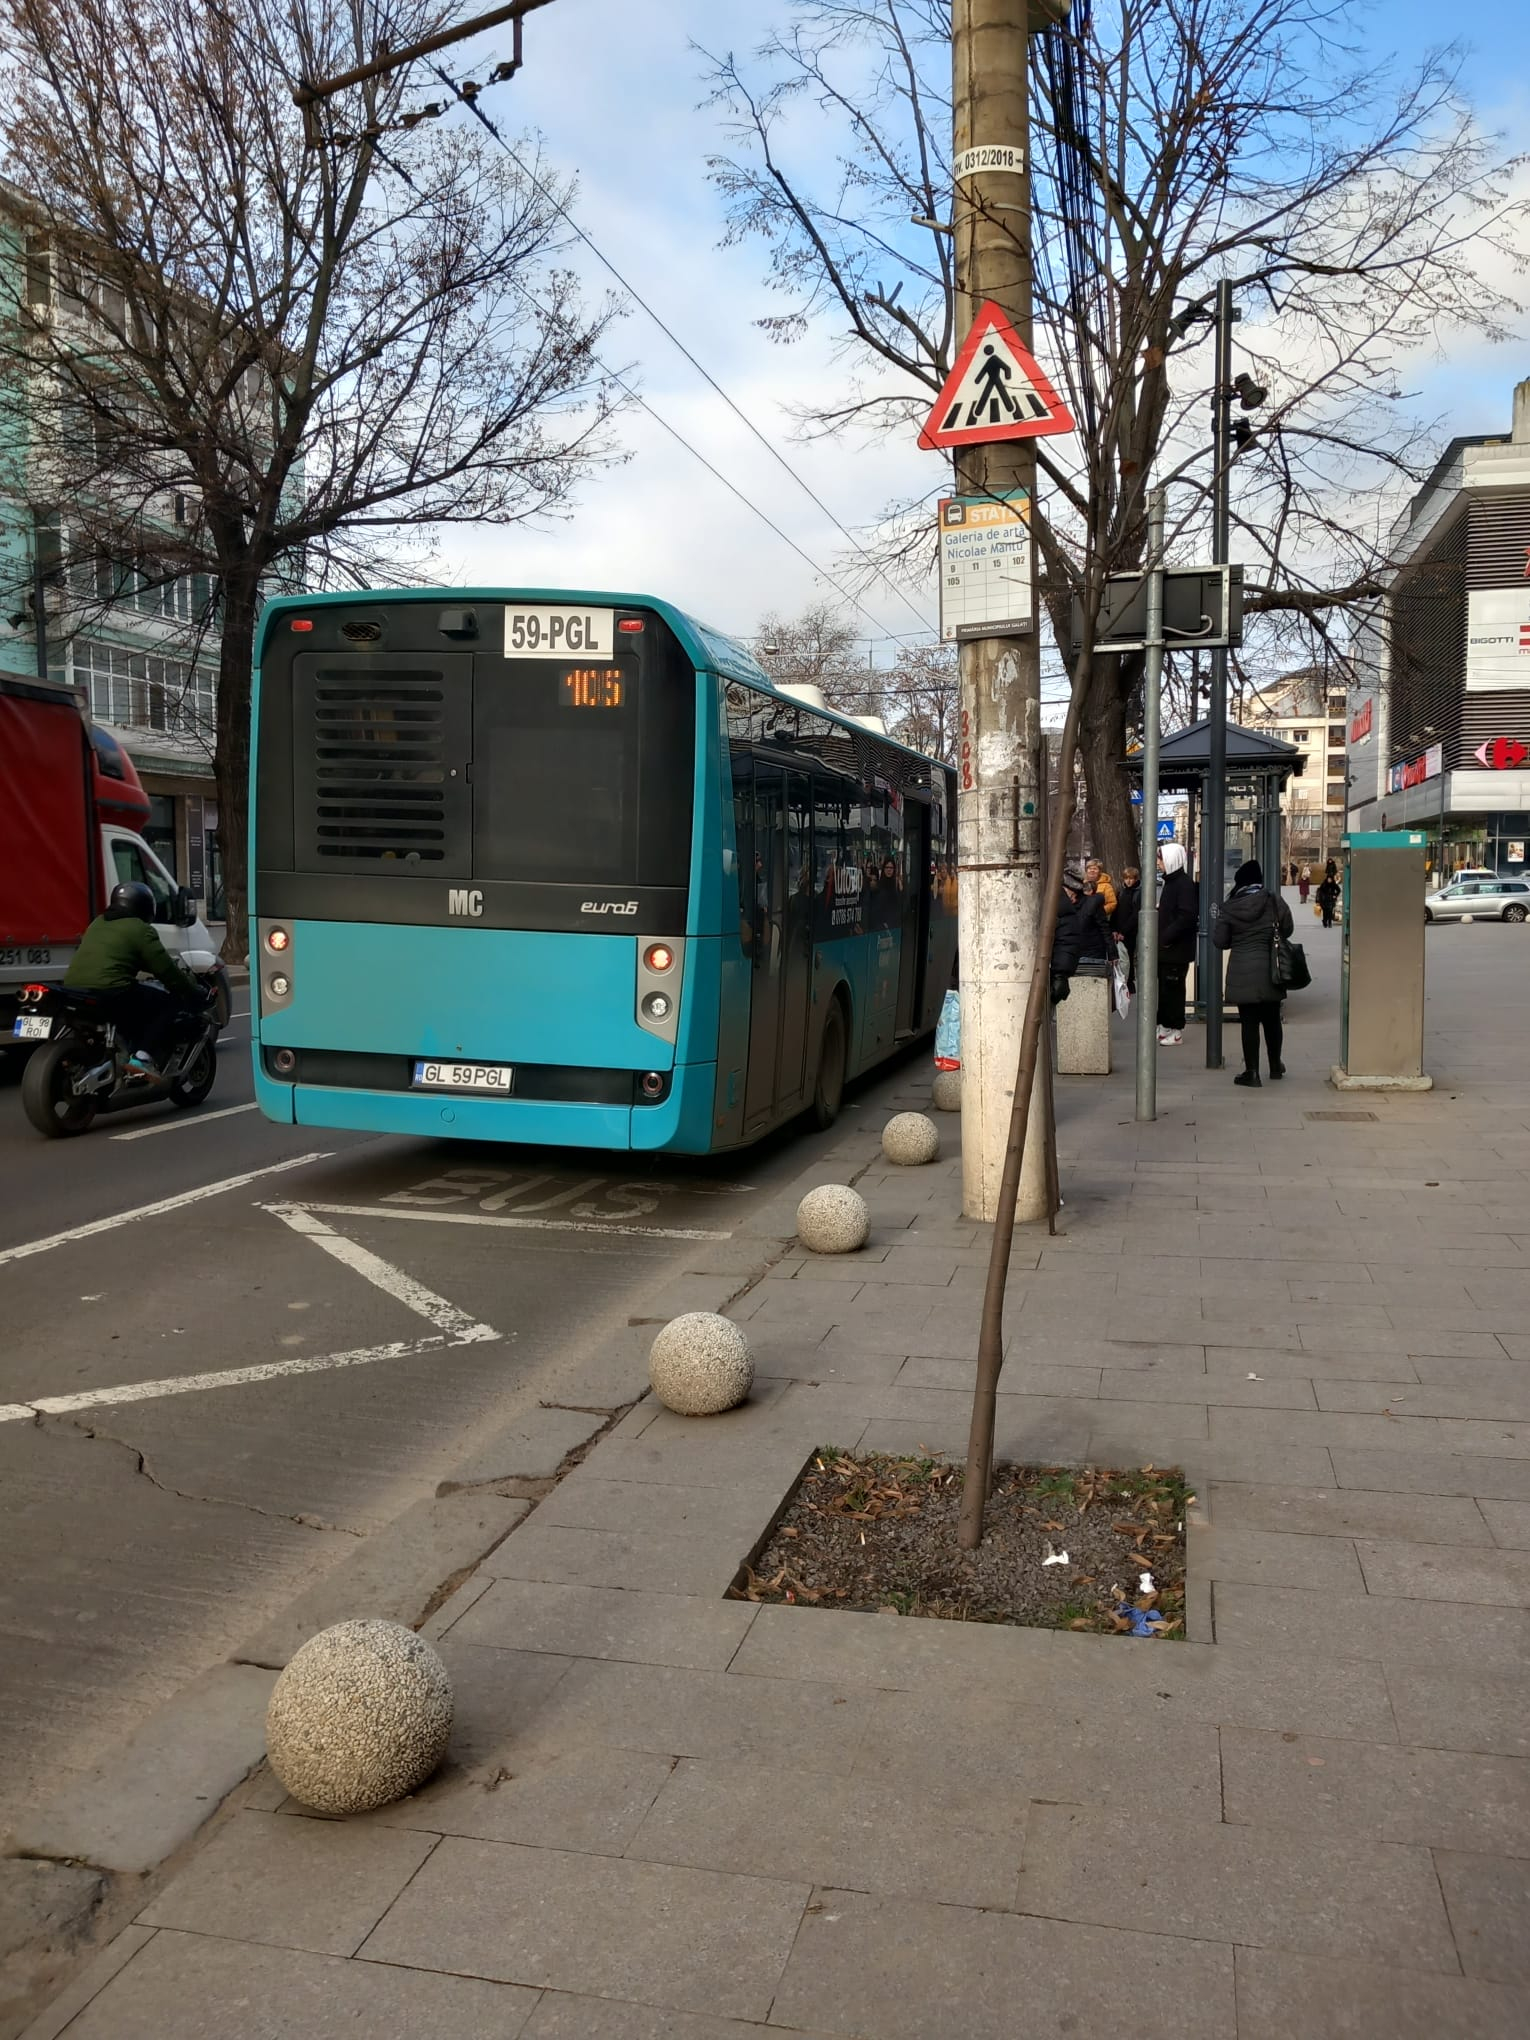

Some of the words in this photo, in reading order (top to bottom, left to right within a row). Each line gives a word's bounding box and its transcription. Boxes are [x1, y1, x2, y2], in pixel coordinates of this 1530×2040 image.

[965, 149, 1014, 170] 0312/2018
[945, 531, 983, 545] Galeria
[986, 529, 1000, 539] de
[1003, 525, 1025, 538] artă
[947, 546, 987, 559] Nicolae
[972, 562, 979, 571] 11
[992, 559, 1002, 568] 15
[1012, 556, 1025, 565] 102
[947, 577, 960, 586] 105
[511, 615, 598, 650] 59-PGL
[1470, 636, 1514, 645] BIGOTTI
[566, 669, 621, 706] 105
[448, 889, 483, 917] MC
[580, 901, 639, 915] euro6
[0, 949, 20, 965] 251
[27, 947, 51, 964] 083
[22, 1017, 33, 1027] GL
[425, 1065, 445, 1082] GL
[452, 1067, 472, 1084] 59
[473, 1068, 507, 1087] PGL
[378, 1168, 680, 1220] BUS
